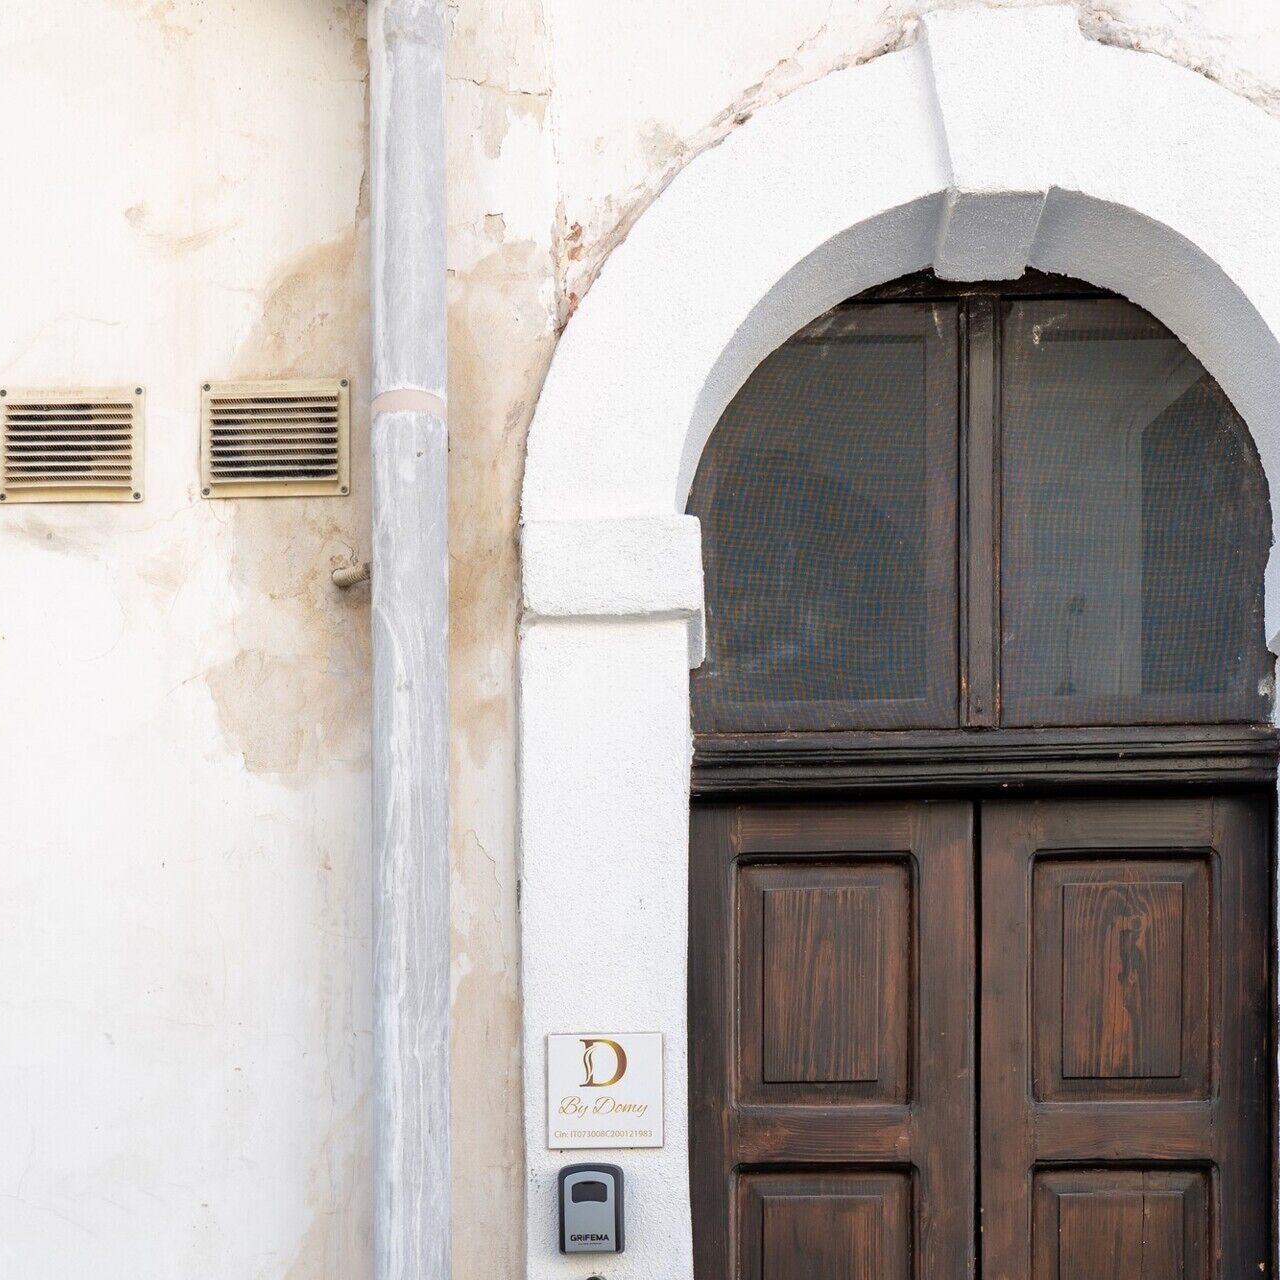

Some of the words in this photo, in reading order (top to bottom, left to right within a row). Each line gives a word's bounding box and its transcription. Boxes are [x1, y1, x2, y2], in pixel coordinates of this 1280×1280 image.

[558, 1096, 588, 1118] By
[593, 1096, 648, 1118] Domy
[570, 1234, 610, 1242] GRIFEMA
